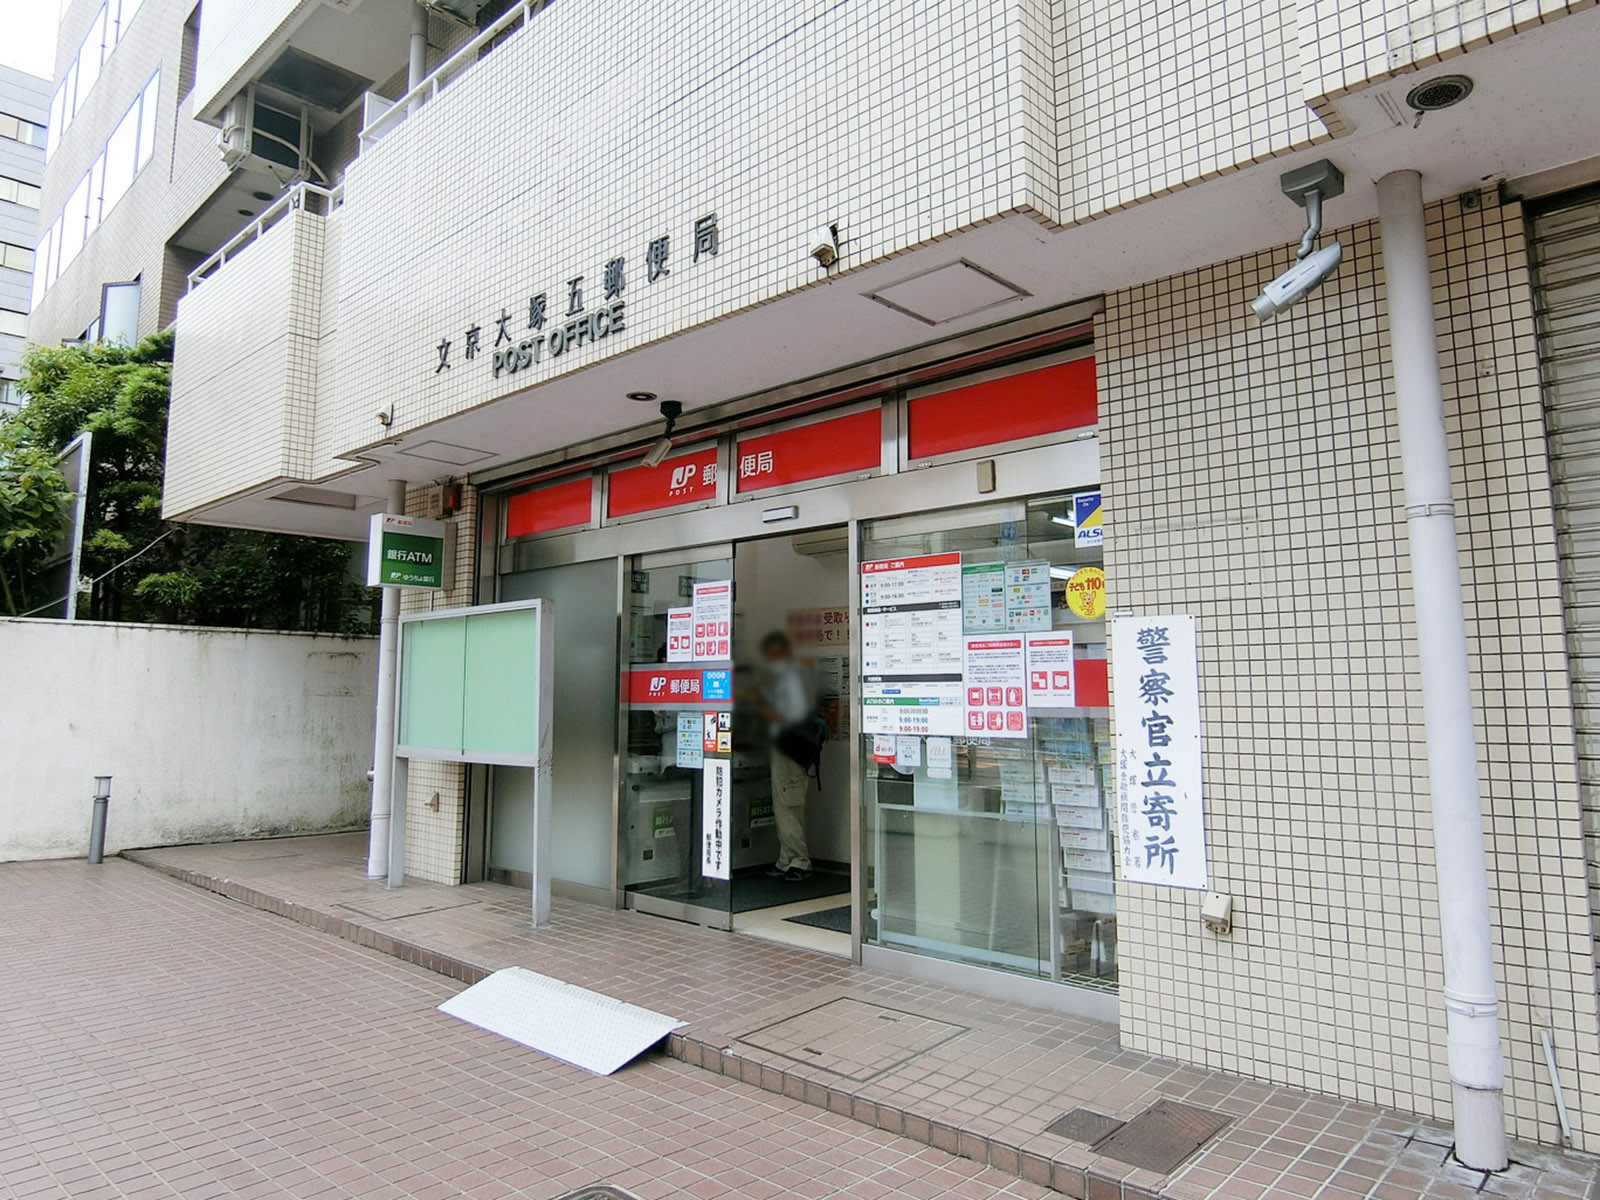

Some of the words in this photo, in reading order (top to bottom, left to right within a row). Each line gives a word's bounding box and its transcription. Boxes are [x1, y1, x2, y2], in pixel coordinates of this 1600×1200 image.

[436, 212, 719, 374] 文京大塚五郵便局
[492, 335, 545, 378] POST
[549, 300, 627, 357] OFFICE
[669, 487, 693, 496] POST
[386, 549, 433, 563] 銀行ATM
[670, 679, 700, 694] 郵便局
[1136, 626, 1180, 876] 警察官立寄所
